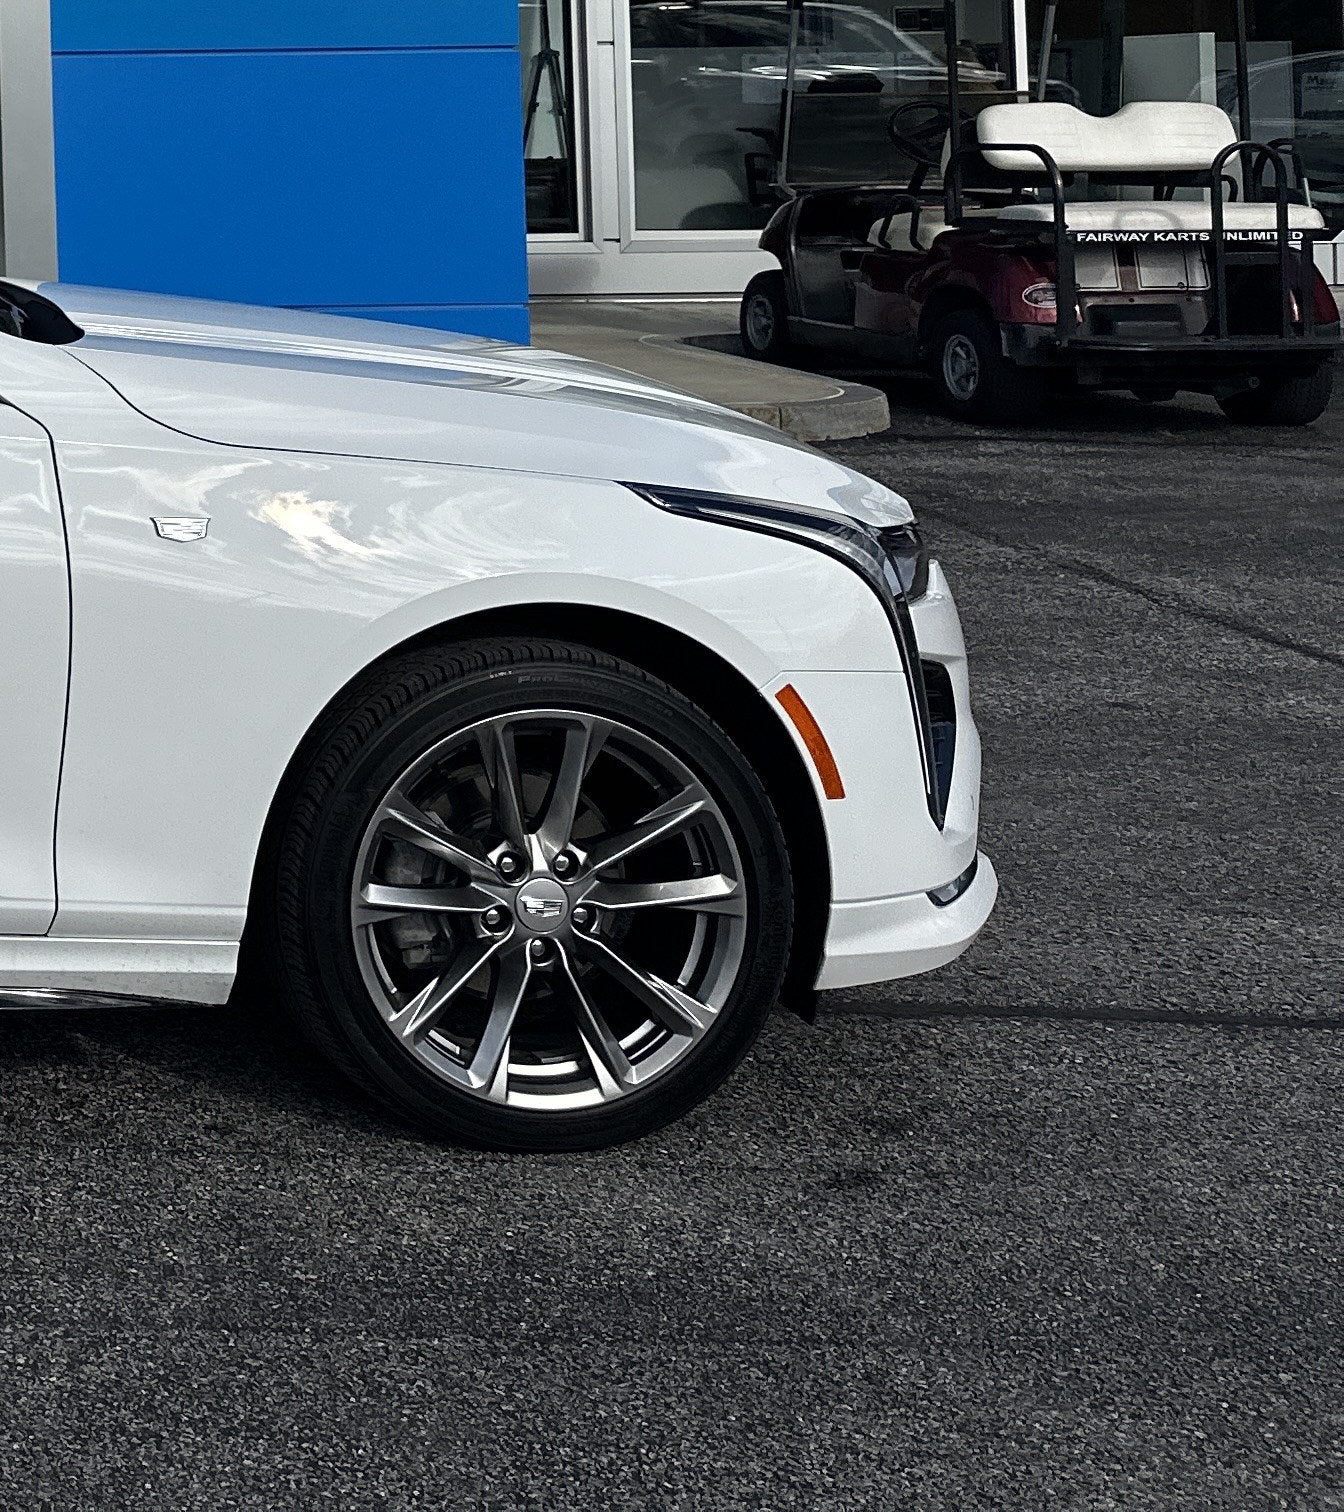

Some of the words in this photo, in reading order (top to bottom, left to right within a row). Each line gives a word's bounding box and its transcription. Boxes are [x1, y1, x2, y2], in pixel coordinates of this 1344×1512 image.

[1076, 231, 1149, 242] FAIRWAY
[1153, 231, 1210, 242] KARTS
[1222, 230, 1304, 241] NLIMITD
